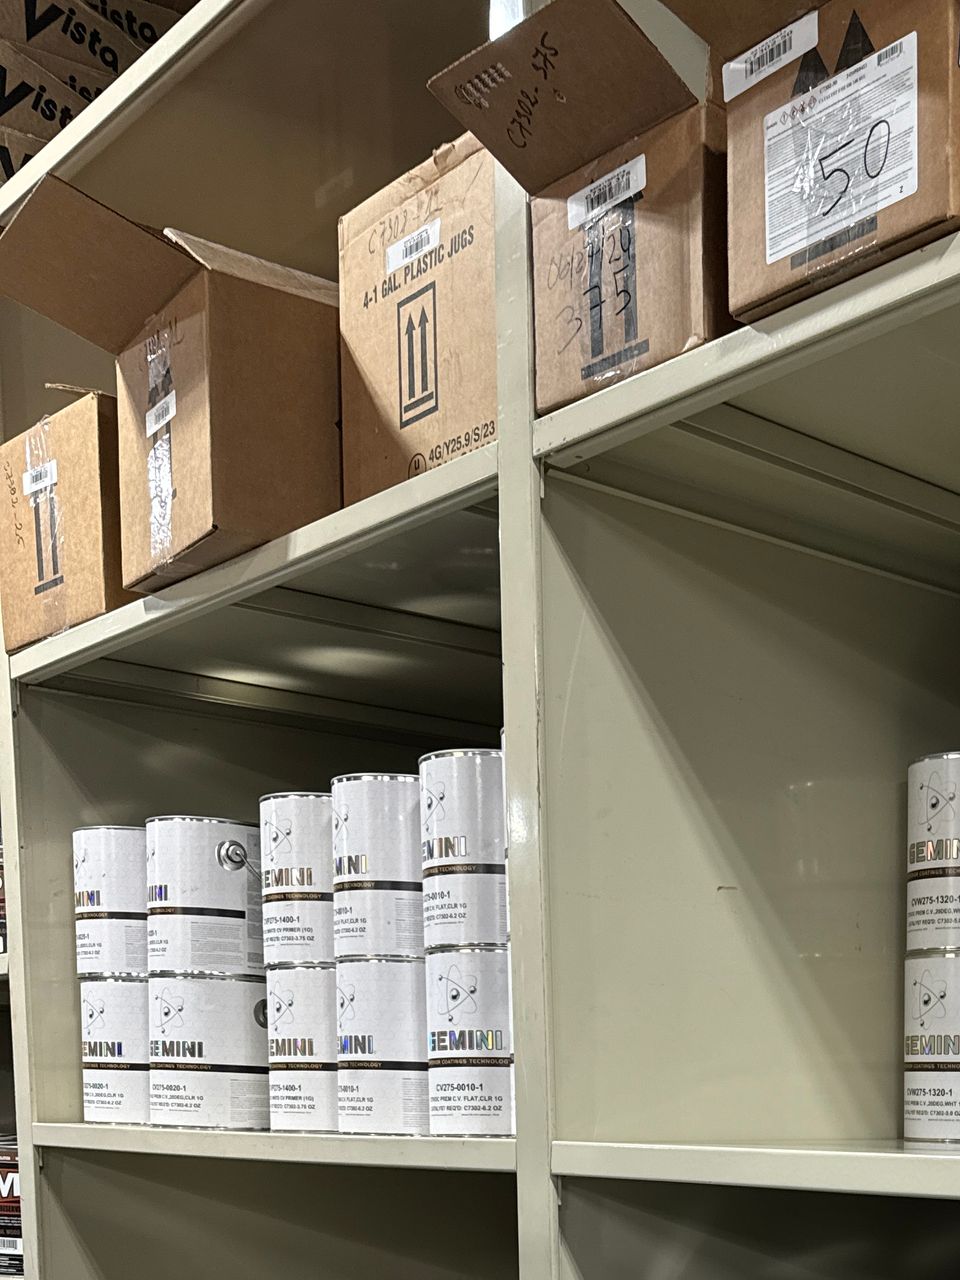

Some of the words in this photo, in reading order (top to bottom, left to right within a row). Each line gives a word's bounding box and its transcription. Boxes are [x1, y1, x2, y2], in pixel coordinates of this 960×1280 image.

[25, 0, 118, 74] Vista
[0, 65, 73, 129] Vist
[819, 119, 890, 216] 50
[363, 285, 377, 310] 4-1
[382, 278, 400, 299] GAL.
[404, 245, 444, 286] PLASTIC
[448, 224, 475, 258] JUGS
[555, 264, 633, 355] 375
